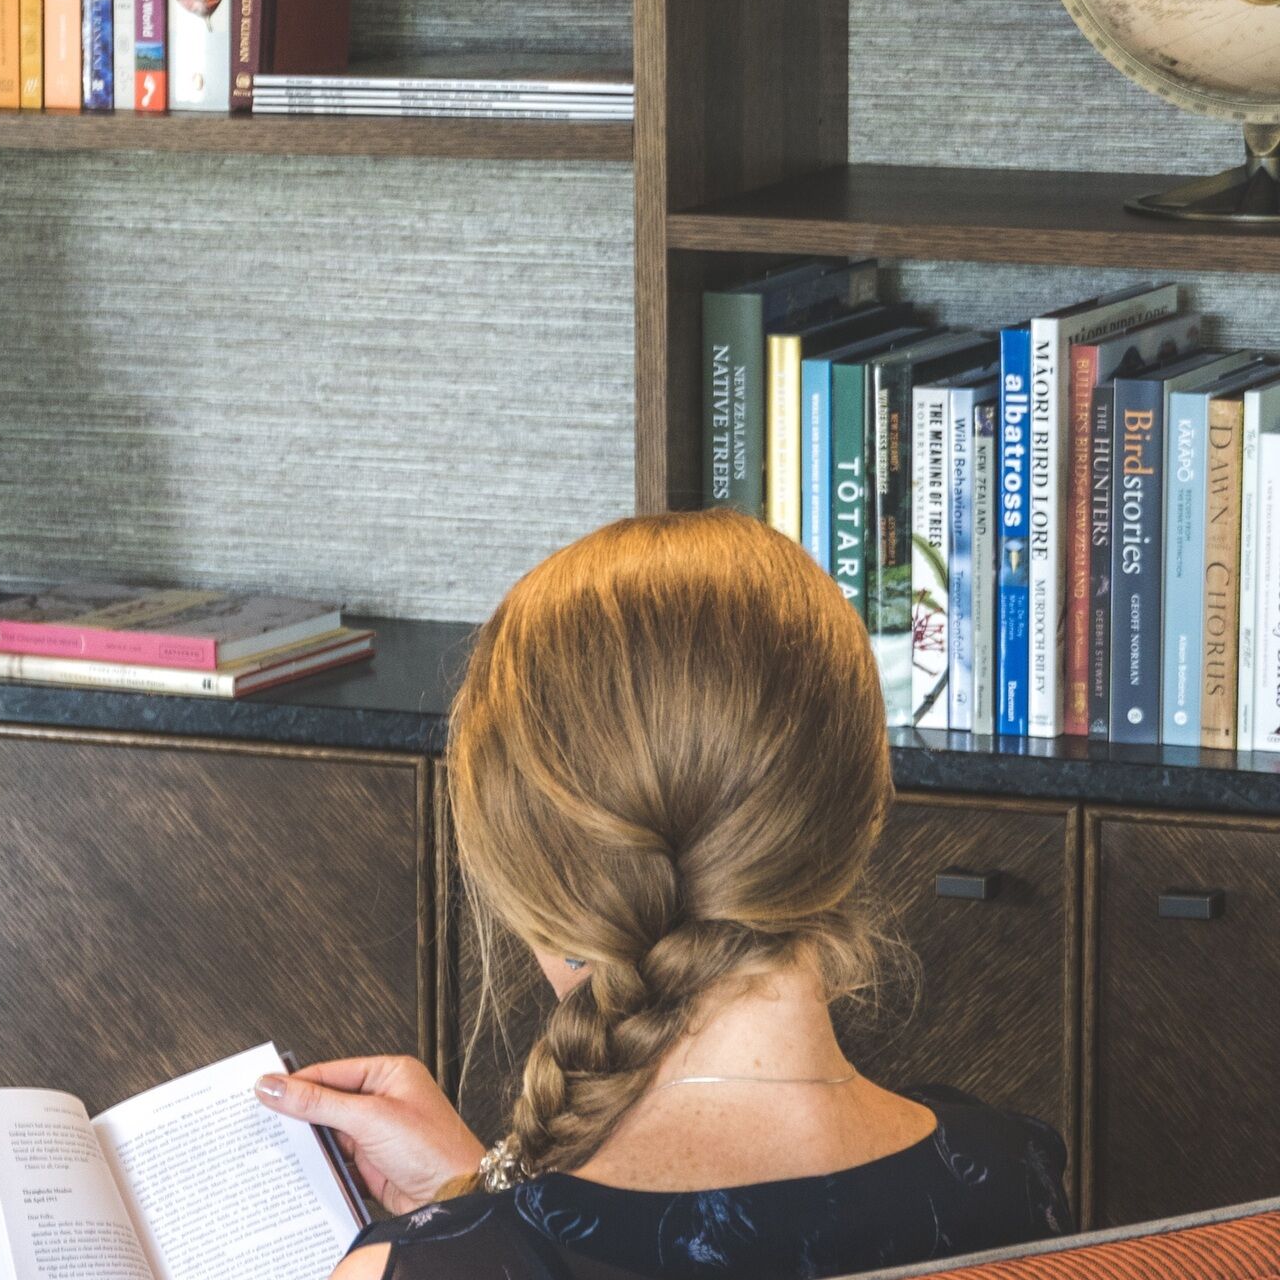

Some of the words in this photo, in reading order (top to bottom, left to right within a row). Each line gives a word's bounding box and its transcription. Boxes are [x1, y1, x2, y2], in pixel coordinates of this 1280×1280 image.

[141, 0, 156, 38] World
[711, 343, 730, 428] NATIVE
[732, 365, 746, 401] NEW
[928, 401, 943, 426] THE
[1031, 339, 1055, 423] MĀORI
[732, 402, 746, 480] ZEALAND'S
[952, 417, 967, 453] Wild
[1003, 373, 1028, 528] albatross
[1095, 404, 1108, 433] THE
[712, 430, 729, 499] TREES
[928, 430, 943, 488] MEANING
[1032, 430, 1051, 487] BIRD
[1092, 436, 1111, 547] HUNTERS
[1121, 409, 1153, 575] Birdstories
[1208, 423, 1234, 526] DAWN
[836, 456, 864, 602] TŌTARA
[928, 491, 942, 507] OF
[928, 509, 943, 549] TREES
[952, 458, 967, 536] Behaviour
[1030, 494, 1050, 562] LORE
[1129, 594, 1141, 633] GEOFF
[1204, 561, 1231, 697] CHORUS
[1129, 634, 1140, 686] NORMAN
